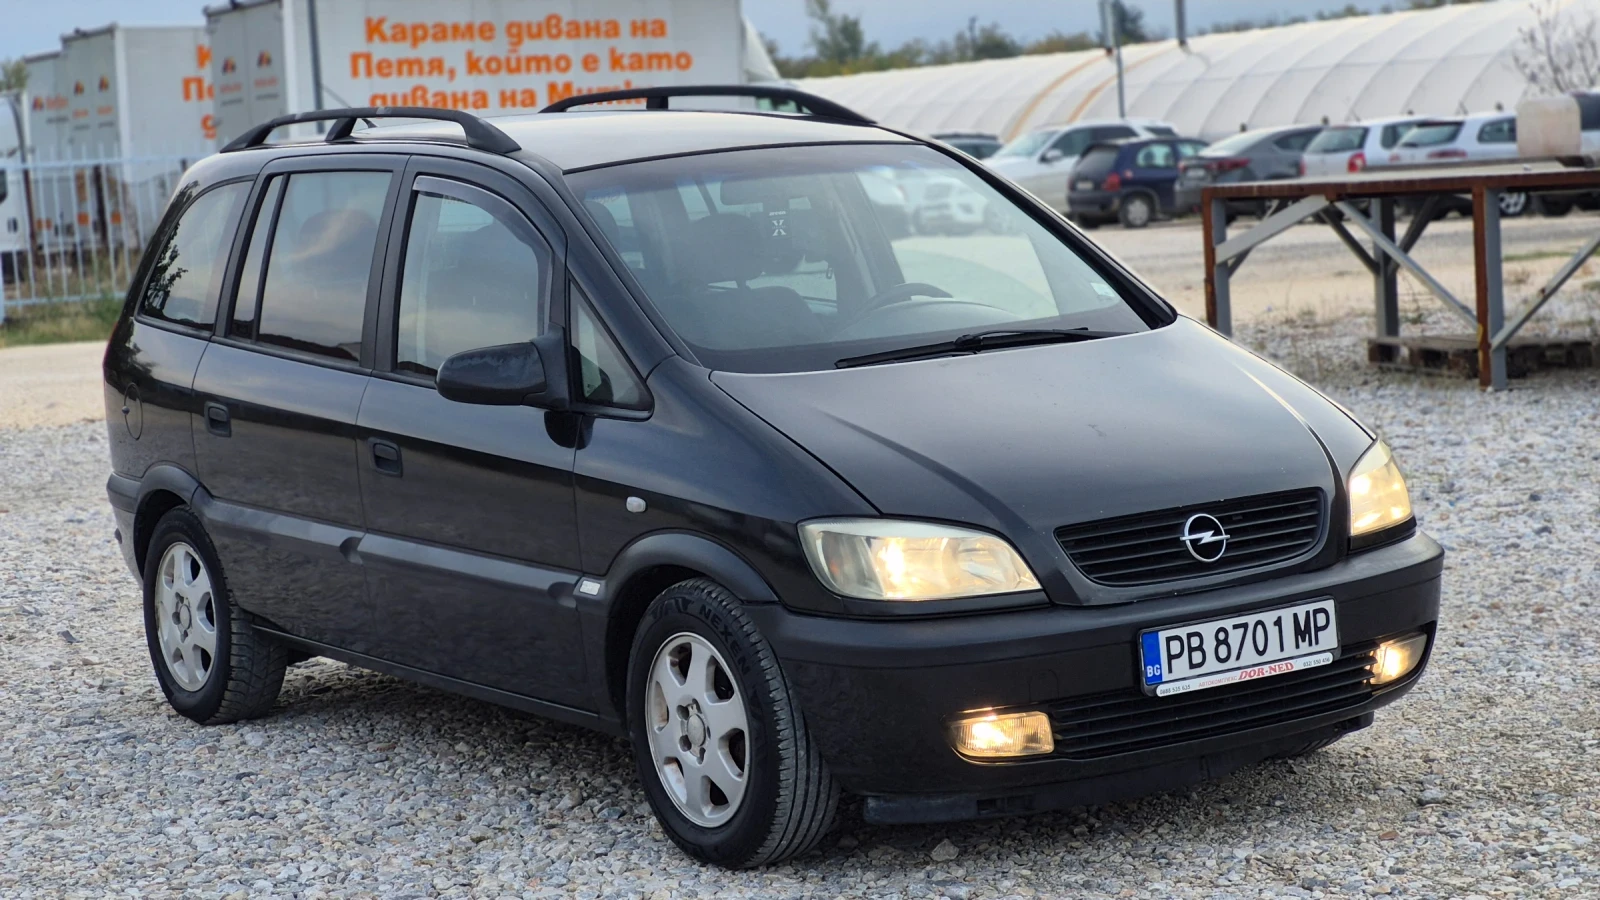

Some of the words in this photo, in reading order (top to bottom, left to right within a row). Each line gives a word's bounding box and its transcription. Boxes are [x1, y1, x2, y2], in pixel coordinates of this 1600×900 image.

[365, 17, 496, 48] Караме
[505, 14, 621, 48] дивана
[630, 19, 668, 38] на
[350, 52, 456, 81] Петя,
[466, 48, 573, 76] който
[582, 52, 600, 72] е
[608, 47, 693, 73] като
[498, 88, 538, 109] на
[699, 604, 751, 676] NEXEN
[1165, 631, 1207, 674] PB
[1213, 615, 1286, 664] 8701
[1292, 607, 1330, 650] MP
[1146, 664, 1161, 678] BG
[1238, 662, 1294, 681] DOR-NED
